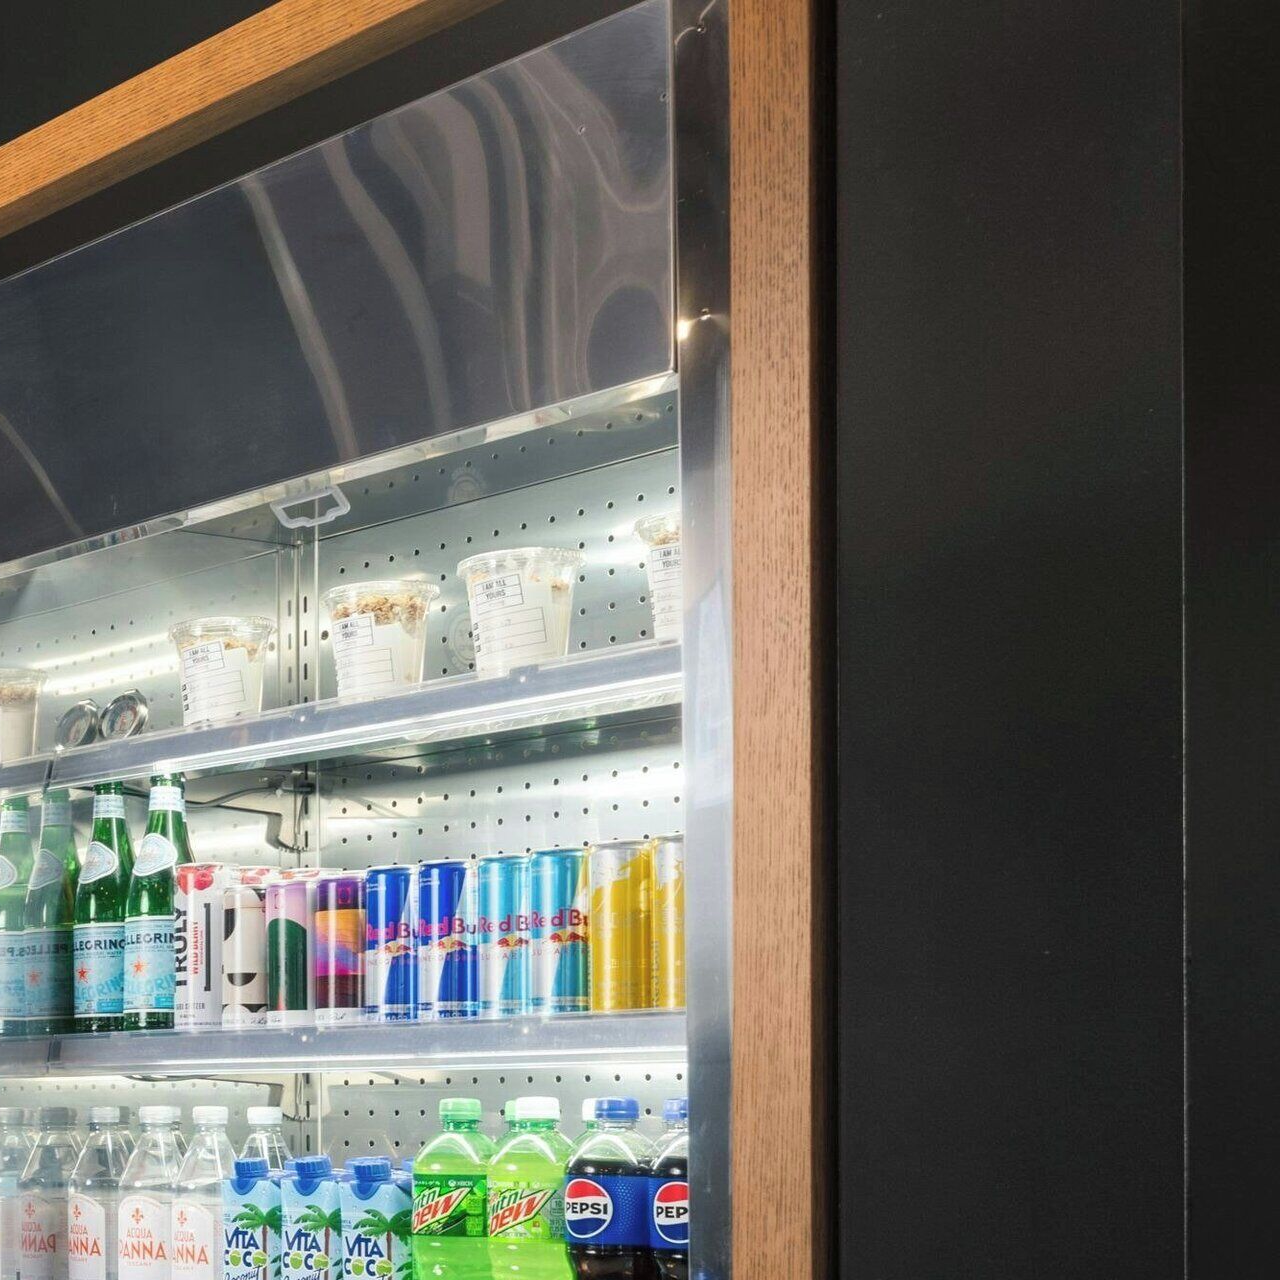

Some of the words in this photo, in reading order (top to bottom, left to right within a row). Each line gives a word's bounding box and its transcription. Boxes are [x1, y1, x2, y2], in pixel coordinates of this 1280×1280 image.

[486, 589, 506, 600] YOURS
[418, 916, 449, 936] Red
[479, 914, 511, 932] Red
[532, 909, 564, 928] Red
[174, 908, 188, 986] TRULY
[566, 1202, 608, 1215] PEPSI
[656, 1206, 688, 1219] PEP
[126, 1227, 153, 1239] ACQUA
[225, 1227, 260, 1249] VITA
[285, 1228, 322, 1252] VITA
[172, 1245, 209, 1265] NNA
[345, 1233, 384, 1258] VITA
[283, 1251, 329, 1271] COCO
[344, 1257, 393, 1277] COCO
